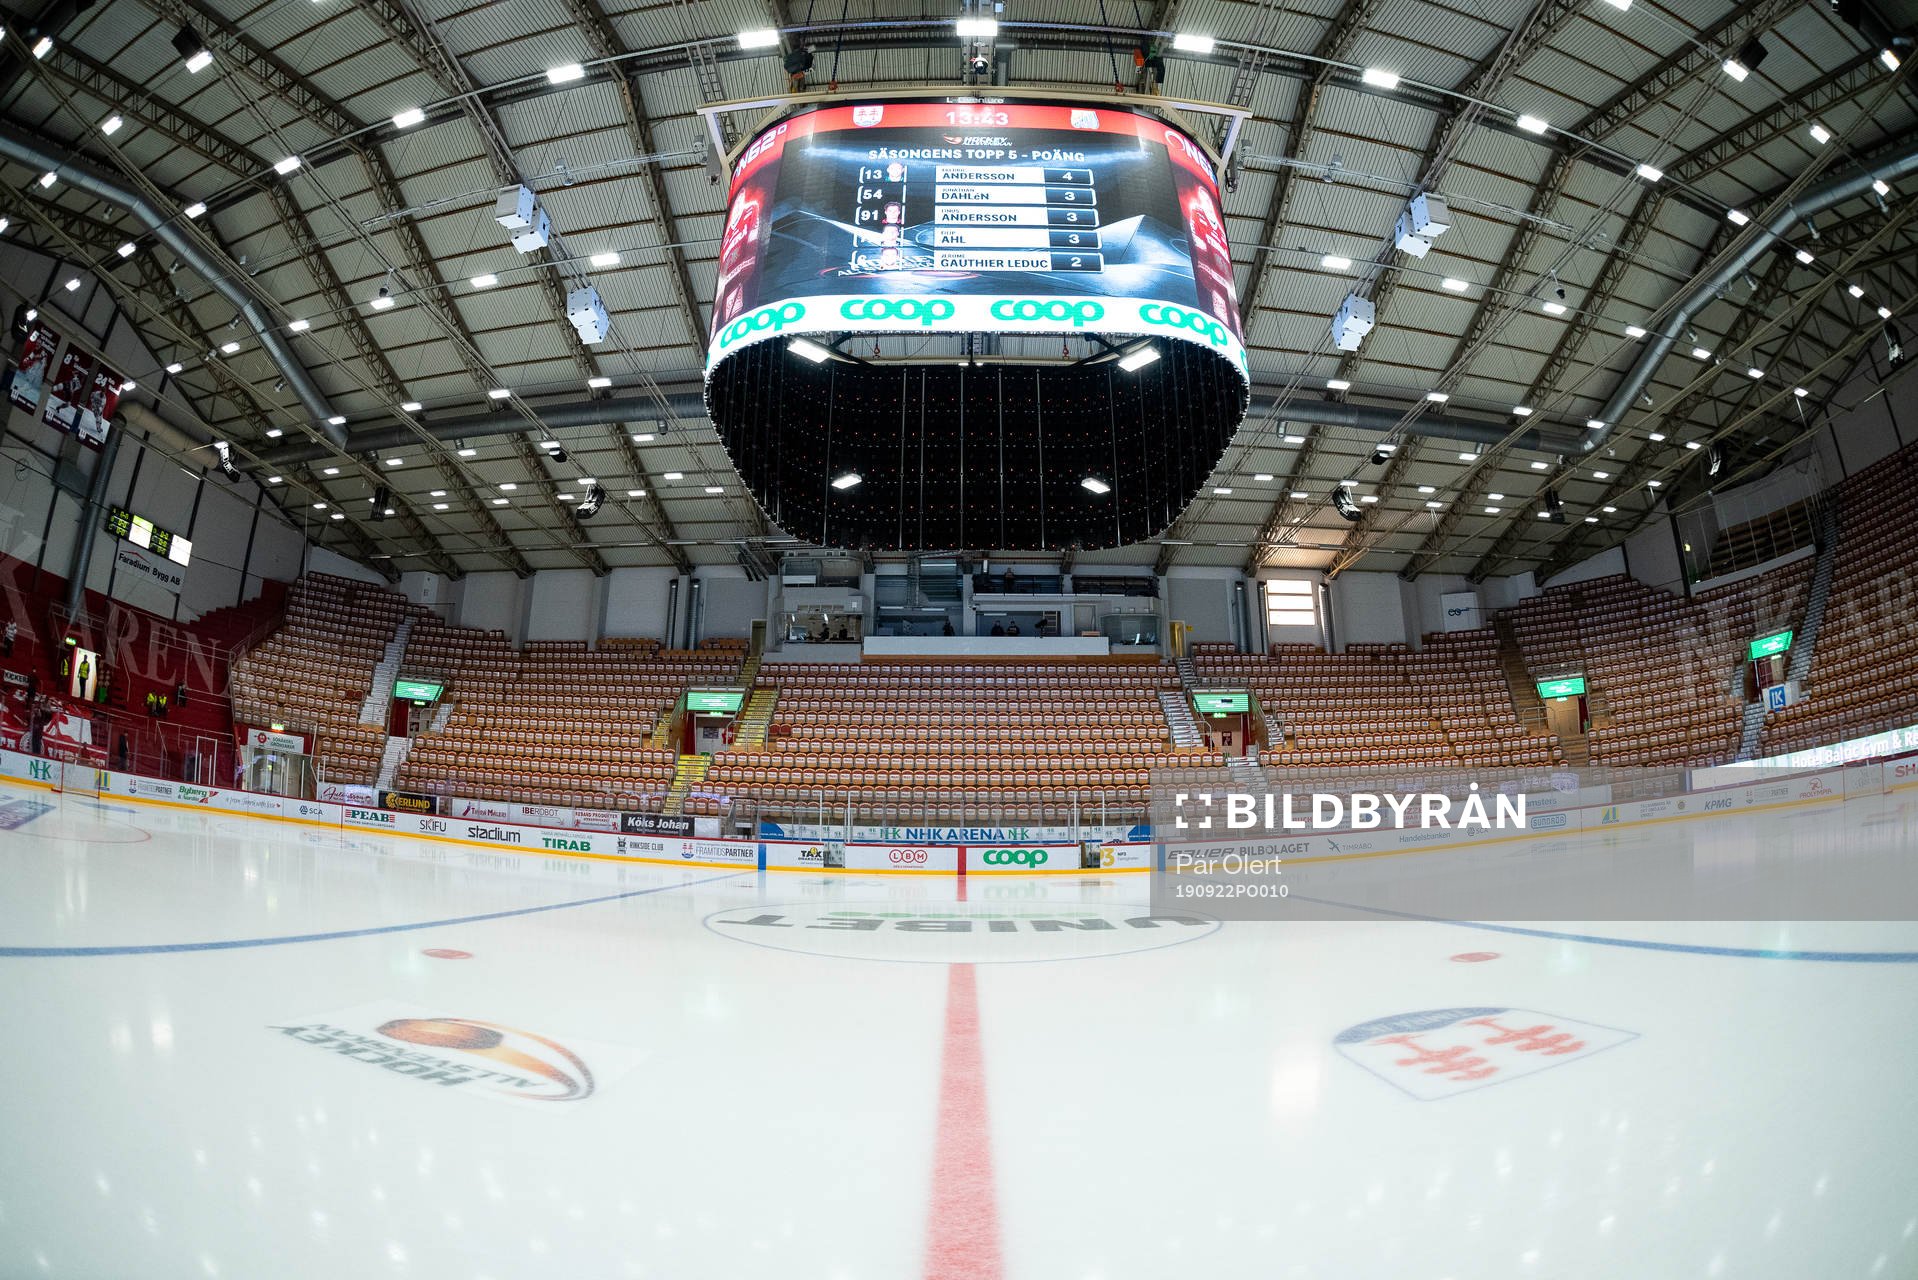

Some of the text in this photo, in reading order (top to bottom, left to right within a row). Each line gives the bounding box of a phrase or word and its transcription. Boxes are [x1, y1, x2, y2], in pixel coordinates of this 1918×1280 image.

[946, 111, 1009, 126] 13:43
[868, 146, 962, 160] SÄSONGENS
[965, 149, 1004, 161] TOPP
[1008, 150, 1018, 161] 5
[1032, 148, 1086, 161] POÄNG
[864, 170, 883, 180] 13
[1062, 172, 1073, 181] 4
[862, 189, 883, 200] 54
[1065, 191, 1076, 201] 3
[860, 210, 879, 221] 91
[942, 214, 1017, 222] ANDERSSON
[1066, 212, 1078, 222] 3
[941, 236, 966, 244] AHL
[1068, 234, 1080, 244] 3
[941, 259, 1049, 268] GAUTHIER LEDUC
[1070, 257, 1082, 268] 2
[840, 299, 955, 326] coop
[990, 299, 1105, 327] coop
[720, 302, 806, 349] coop
[1139, 303, 1228, 347] coop
[118, 553, 181, 586] Faradium Bygg AB
[1791, 751, 1822, 767] Hotel
[1861, 739, 1889, 757] Gym
[1892, 733, 1903, 748] &
[179, 785, 208, 797] Byberg
[1799, 787, 1832, 799] PROLYMPIA
[308, 807, 324, 815] SCA
[1704, 798, 1732, 811] KPMG
[351, 809, 390, 823] PEAB
[522, 806, 559, 817] IBEROBOT
[419, 817, 447, 832] SKIFU
[627, 816, 689, 830] Köks Johan
[467, 825, 521, 843] stadium
[906, 828, 943, 841] NHK
[946, 828, 1005, 841] ARENA
[1399, 831, 1451, 843] Handelsbanken
[542, 837, 591, 852] TIRAB
[629, 841, 664, 851] RINKSIDE CLUB
[1239, 842, 1310, 857] BILBOLAGET
[695, 845, 754, 858] FRAMTIDSPARTNER
[982, 849, 1049, 869] coop
[716, 914, 1210, 933] UNIBET
